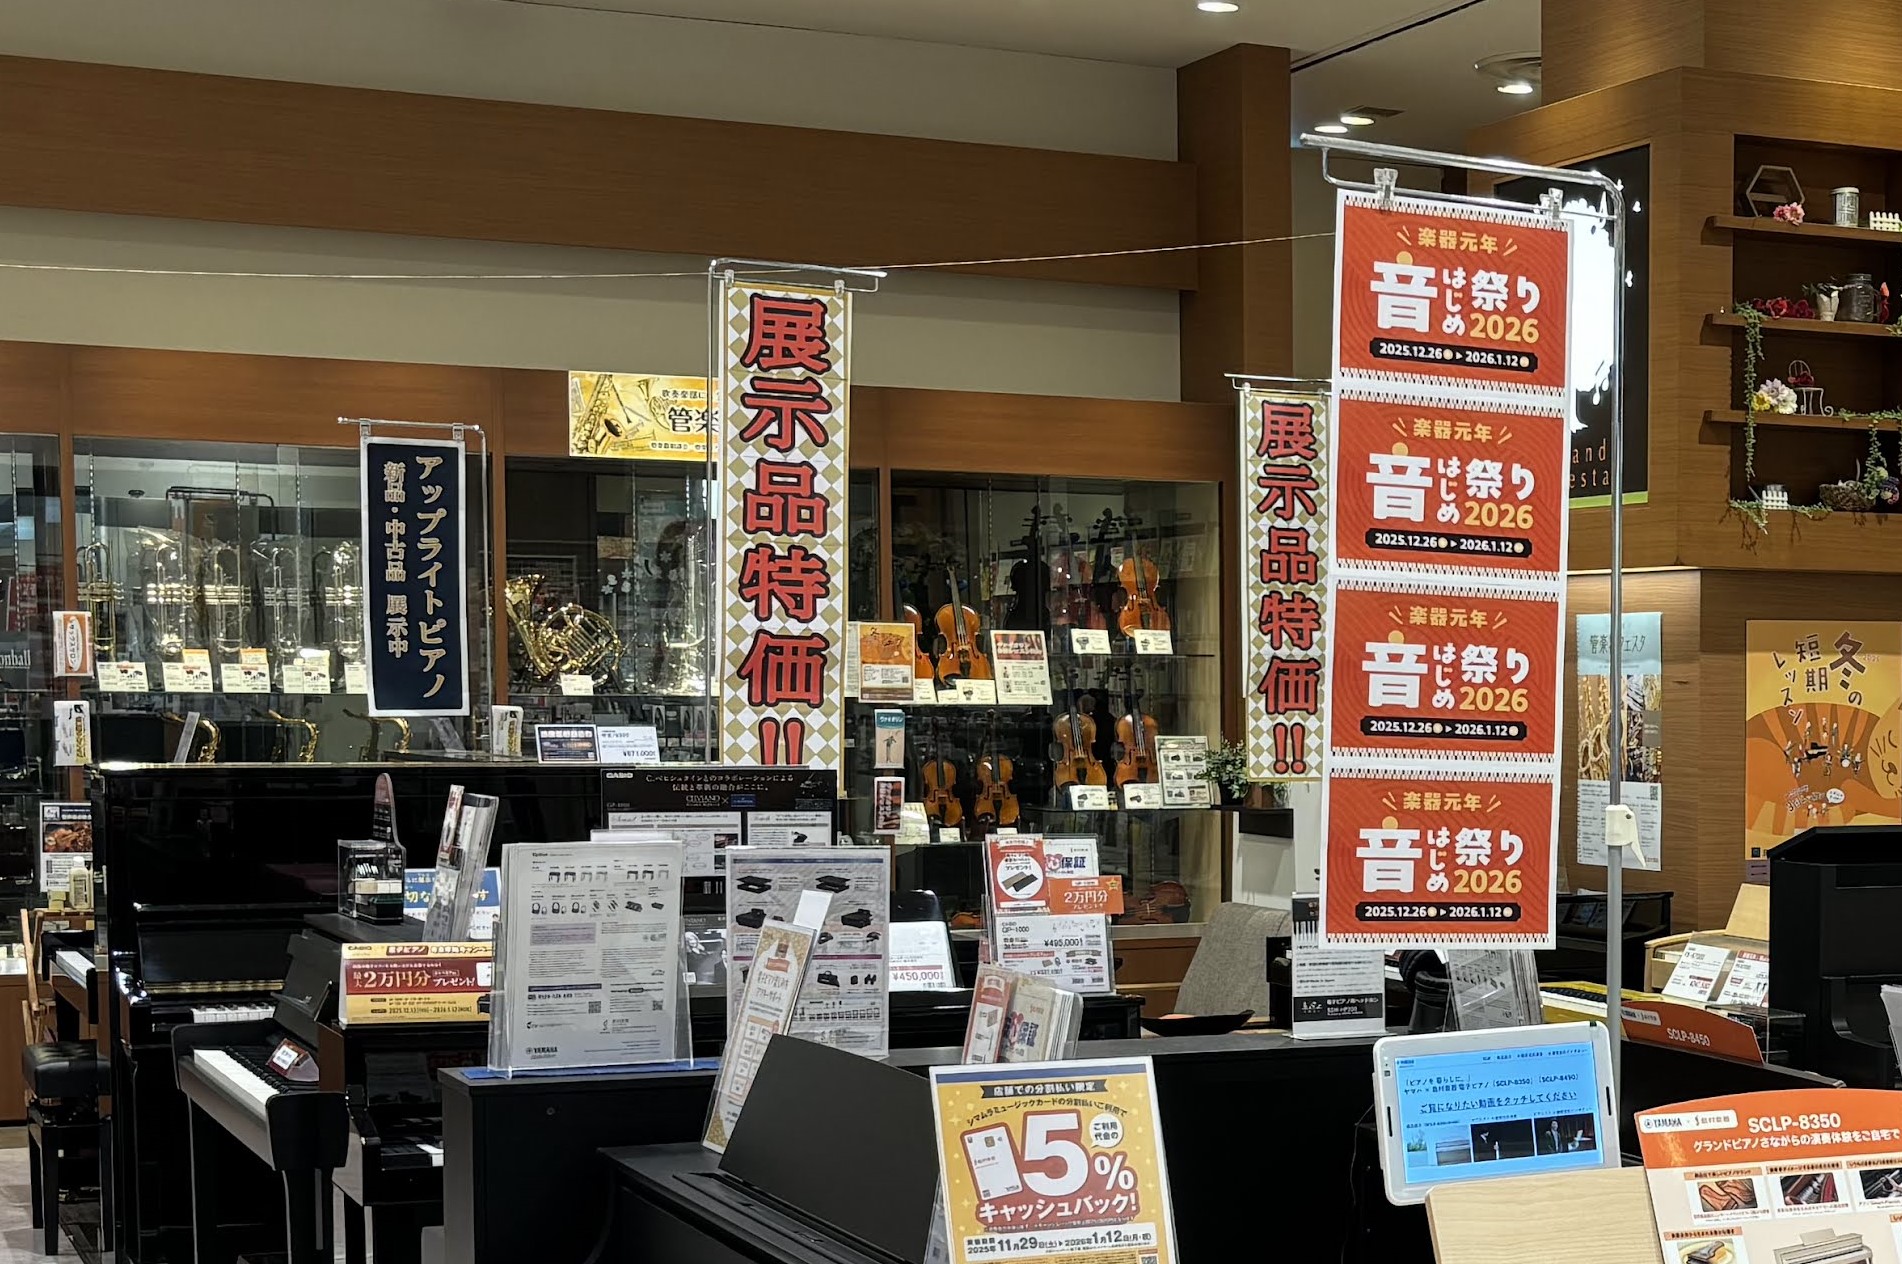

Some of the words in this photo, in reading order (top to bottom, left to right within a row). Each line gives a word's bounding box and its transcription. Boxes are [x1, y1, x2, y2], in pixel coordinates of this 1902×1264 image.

[1418, 227, 1498, 254] 楽器元年
[1370, 252, 1438, 333] 音
[1442, 267, 1466, 335] はじめ
[1471, 269, 1540, 314] 祭り
[1469, 313, 1539, 344] 2026
[1379, 342, 1442, 360] 2025.12.26
[1465, 351, 1518, 367] 2026.1.12
[1413, 418, 1492, 443] 楽器元年
[1365, 442, 1433, 523] 音
[1437, 457, 1461, 525] はじめ
[1465, 458, 1534, 501] 祭り
[384, 461, 406, 583] 新品・中古品
[1464, 501, 1534, 529] 2026
[1375, 532, 1438, 548] 2025.12.26
[1460, 537, 1513, 553] 2026.1.12
[415, 455, 447, 698] アップライトピアノ
[1257, 400, 1321, 775] 展示品特価!!
[386, 594, 408, 659] 展示中
[1409, 606, 1488, 628] 楽器元年
[1362, 631, 1428, 708] 音
[1433, 644, 1455, 710] はじめ
[1460, 644, 1529, 684] 祭り
[1795, 634, 1829, 692] 短期
[1459, 686, 1528, 713] 2026
[1773, 652, 1804, 725] レッスン
[1370, 720, 1432, 735] 2025.12.26
[1455, 722, 1508, 736] 2026.1.12
[1403, 792, 1481, 811] 楽器元年
[1355, 816, 1422, 894] 音
[1427, 827, 1450, 893] はじめ
[1454, 828, 1523, 867] 祭り
[1453, 869, 1522, 894] 2026
[1064, 890, 1108, 904] 2万円分
[1365, 905, 1427, 918] 2025.12.26
[1448, 905, 1502, 918] 2026.1.12
[363, 970, 431, 989] 2万円分
[993, 1081, 1096, 1097] 店舗での分割払い限定
[1748, 1112, 1841, 1134] SCLP-8350
[1693, 1128, 1901, 1153] グランドピアノさながらの演奏体験をご自宅で
[979, 1192, 1138, 1224] キャッシュバック!
